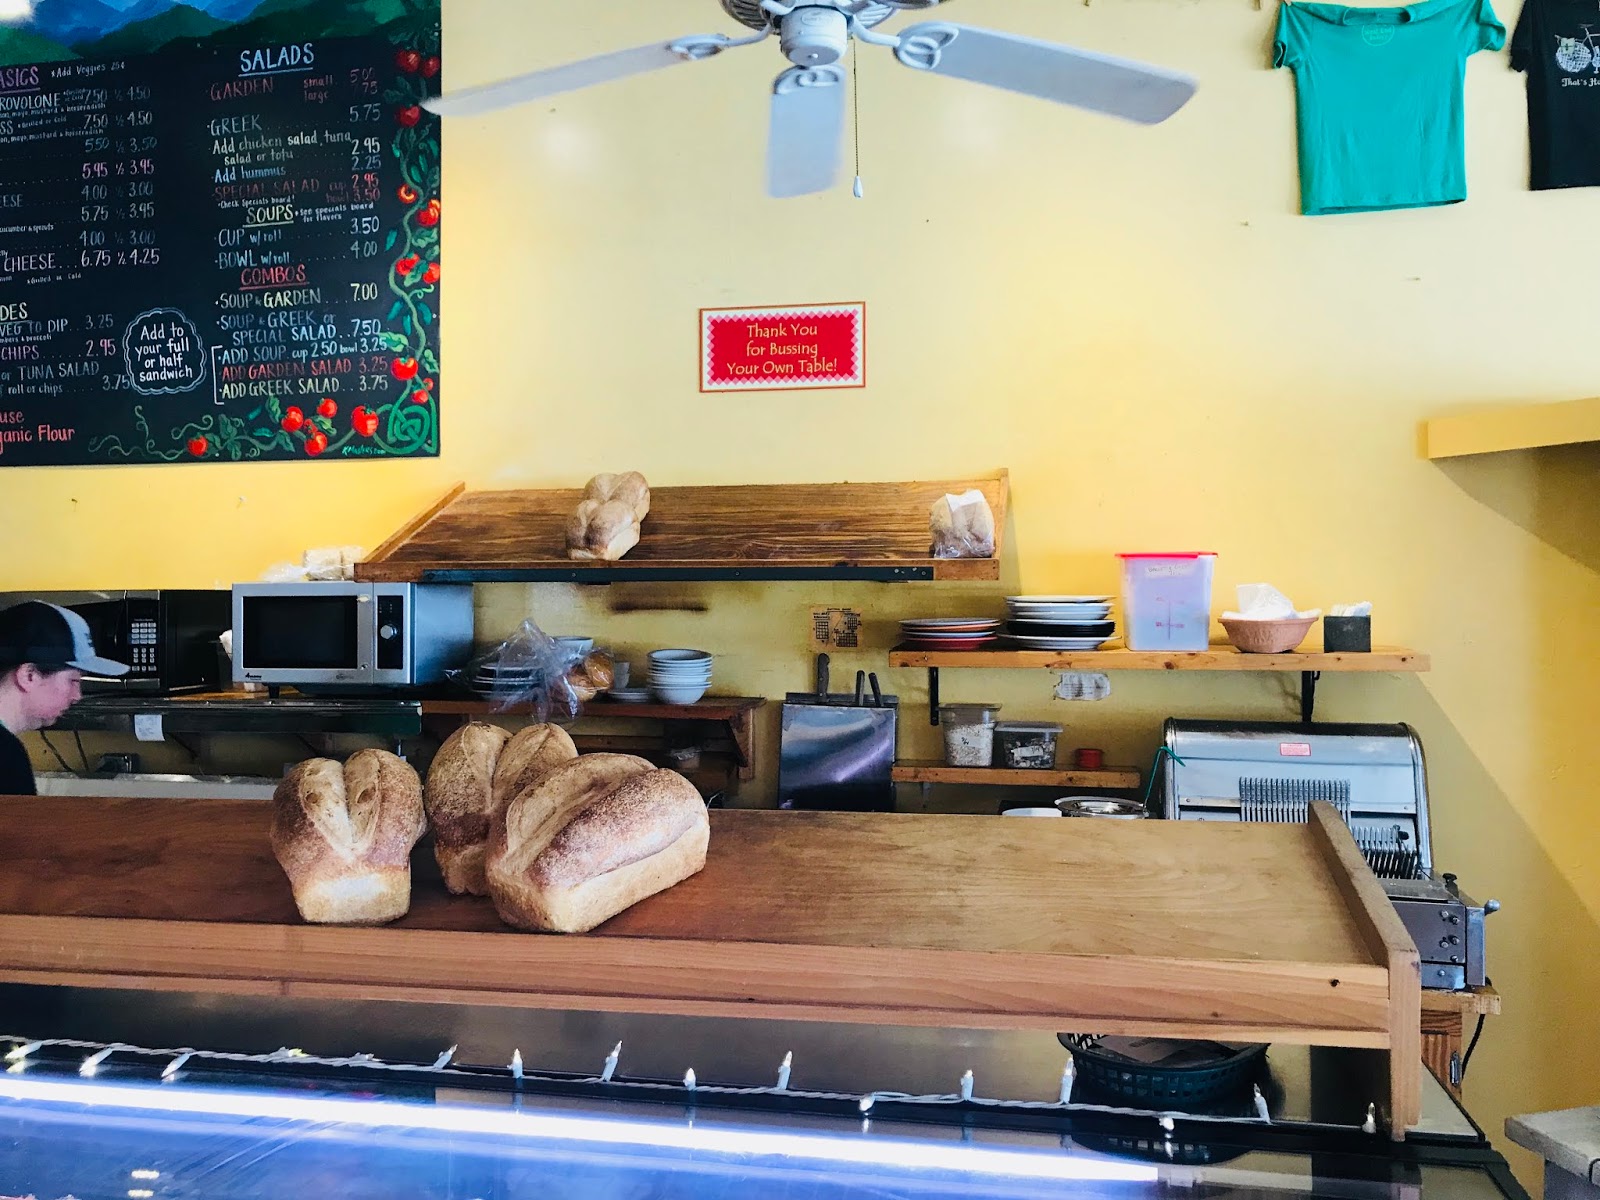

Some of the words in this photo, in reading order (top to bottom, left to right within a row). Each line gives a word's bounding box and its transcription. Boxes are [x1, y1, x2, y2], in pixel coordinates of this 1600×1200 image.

[240, 42, 314, 72] SALADS
[76, 63, 106, 77] Veggies
[210, 77, 273, 101] GARDEN
[303, 75, 333, 88] small
[1561, 77, 1588, 87] That's
[127, 110, 153, 126] 4.50
[210, 115, 262, 136] GREEK
[349, 102, 381, 123] 5.75
[212, 136, 235, 155] Add
[238, 135, 282, 151] chicken
[224, 153, 251, 166] salad
[256, 152, 268, 161] or
[270, 148, 294, 162] tofu
[351, 136, 381, 155] 2.95
[82, 161, 109, 179] 5.95
[129, 158, 155, 175] 3.95
[214, 167, 237, 184] Add
[241, 165, 287, 179] hummus
[351, 154, 382, 171] 2.25
[128, 181, 154, 198] 3.00
[351, 171, 379, 189] 2.95
[81, 205, 109, 222] 5.75
[129, 202, 156, 219] 3.95
[246, 203, 294, 224] SOUPS
[299, 207, 313, 216] see
[350, 201, 374, 211] board
[218, 227, 245, 247] CUP
[350, 215, 380, 235] 3.50
[4, 252, 56, 273] CHEESE
[80, 249, 111, 267] 6.75
[129, 247, 160, 266] 4.25
[218, 249, 258, 270] BOWL
[240, 263, 307, 286] COMBOS
[219, 291, 253, 309] SOUP
[263, 287, 322, 309] GARDEN
[350, 281, 378, 302] 7.00
[47, 318, 68, 333] DIP
[85, 313, 114, 330] 3.25
[220, 313, 255, 331] SOUP
[267, 309, 317, 329] GREEK
[323, 313, 337, 325] or
[746, 322, 788, 339] Thank
[790, 323, 818, 337] You
[140, 326, 165, 341] Add
[170, 322, 185, 337] to
[232, 328, 286, 348] SPECIAL
[291, 323, 337, 343] SALAD
[351, 318, 381, 338] 7.50
[1, 343, 40, 361] CHIPS
[85, 338, 117, 358] 2.95
[135, 343, 163, 361] your
[166, 337, 191, 354] full
[222, 350, 249, 365] ADD
[253, 345, 288, 363] SOUP
[291, 348, 310, 364] cup
[310, 340, 338, 358] 2.50
[339, 341, 358, 354] bowl
[360, 336, 388, 354] 3.25
[746, 340, 767, 357] for
[769, 342, 819, 358] Bussing
[16, 364, 55, 381] TUNA
[58, 361, 100, 378] SALAD
[144, 359, 156, 369] or
[159, 353, 184, 368] half
[222, 366, 247, 382] ADD
[248, 360, 306, 380] GARDEN
[310, 358, 352, 376] SALAD
[358, 355, 389, 374] 3.25
[726, 362, 760, 376] Your
[762, 360, 795, 375] Own
[797, 356, 839, 374] Table!
[8, 383, 25, 395] roll
[26, 385, 36, 394] or
[38, 382, 64, 398] chips
[102, 373, 131, 392] 3.75
[139, 367, 194, 383] sandwich
[222, 382, 247, 400] ADD
[249, 379, 295, 398] GREEK
[298, 376, 341, 395] SALAD
[358, 373, 389, 392] 3.75
[37, 423, 77, 443] Flour
